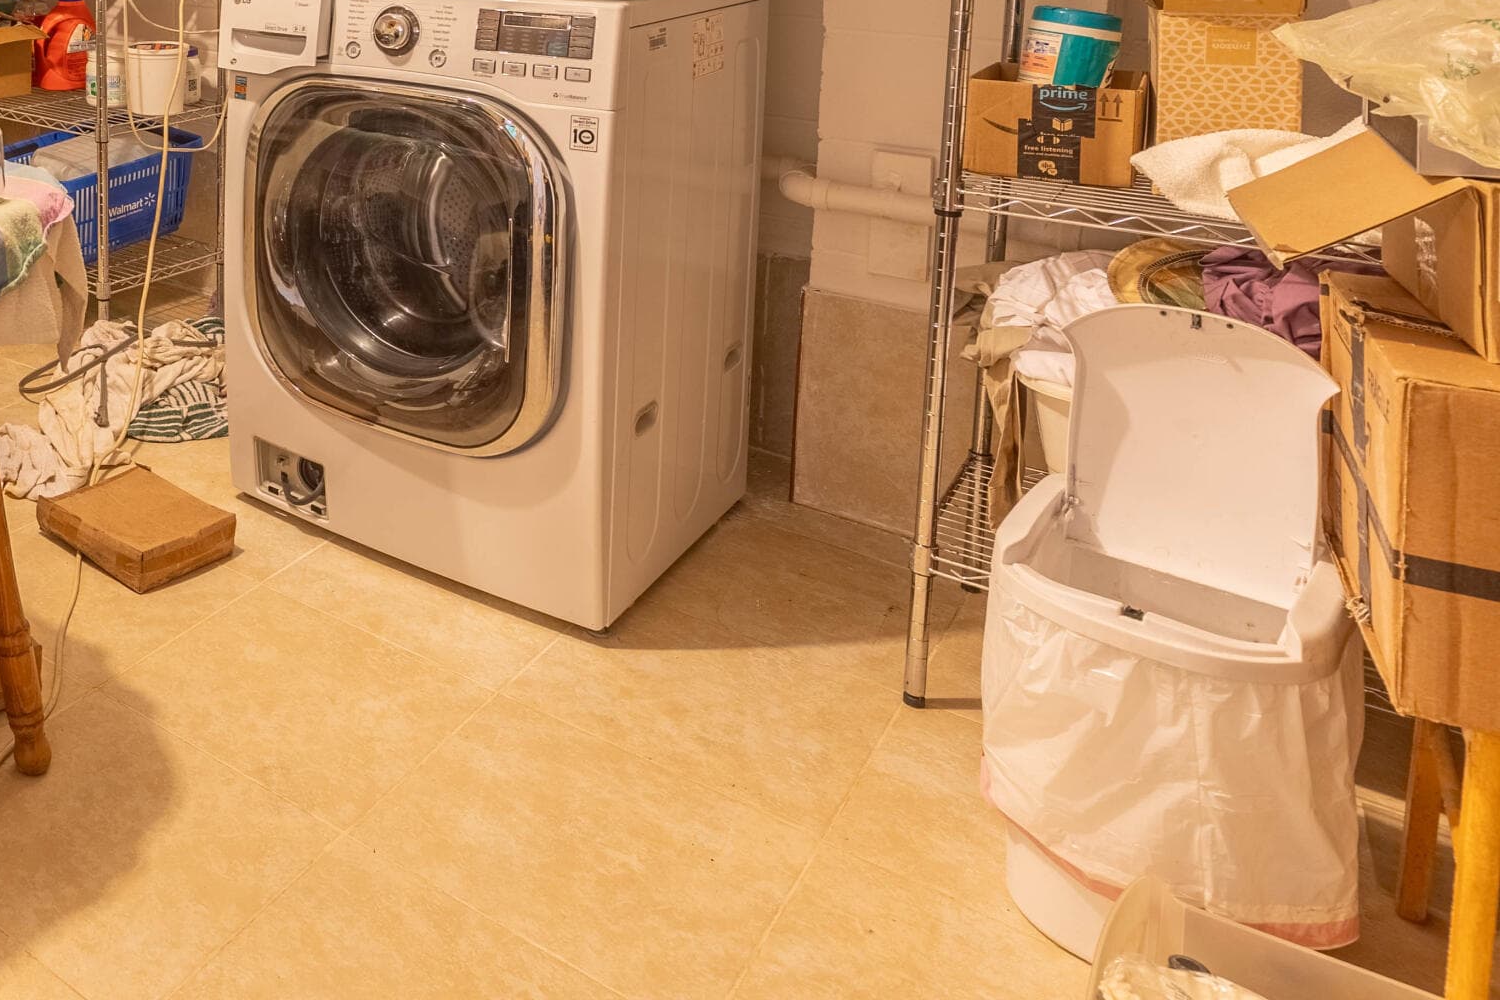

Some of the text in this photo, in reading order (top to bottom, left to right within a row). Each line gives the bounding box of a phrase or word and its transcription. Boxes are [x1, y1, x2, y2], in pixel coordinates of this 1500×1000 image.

[1039, 86, 1088, 100] prime
[573, 128, 595, 145] 10
[1024, 144, 1039, 152] free
[1040, 145, 1074, 155] listening
[109, 198, 143, 218] Walmart
